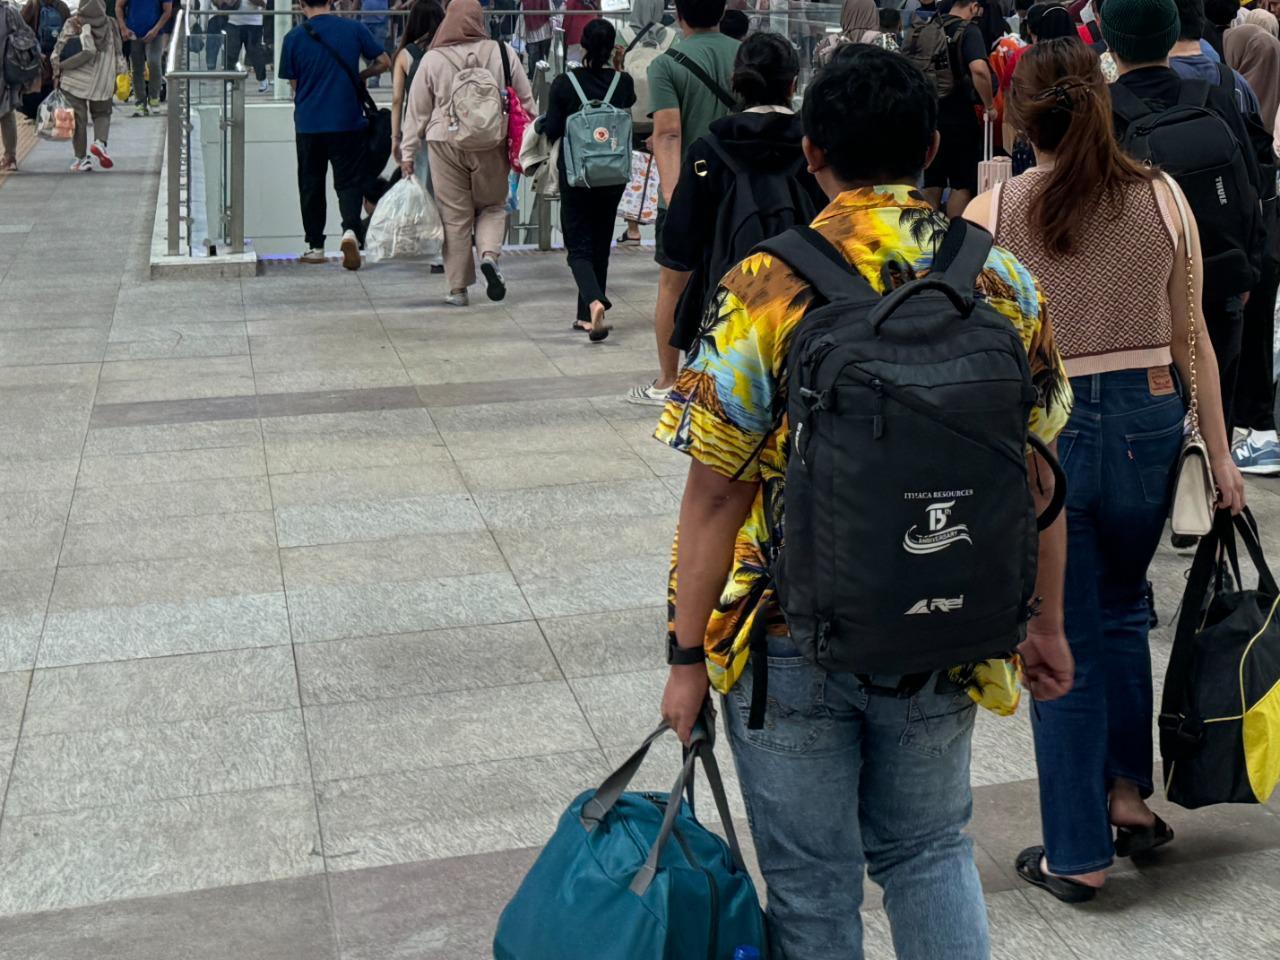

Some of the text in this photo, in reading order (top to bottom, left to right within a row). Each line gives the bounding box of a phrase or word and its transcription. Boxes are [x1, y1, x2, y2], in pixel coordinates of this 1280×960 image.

[1236, 445, 1250, 460] N
[932, 488, 974, 499] RESOURCES
[918, 531, 958, 544] ANNIVERSARY
